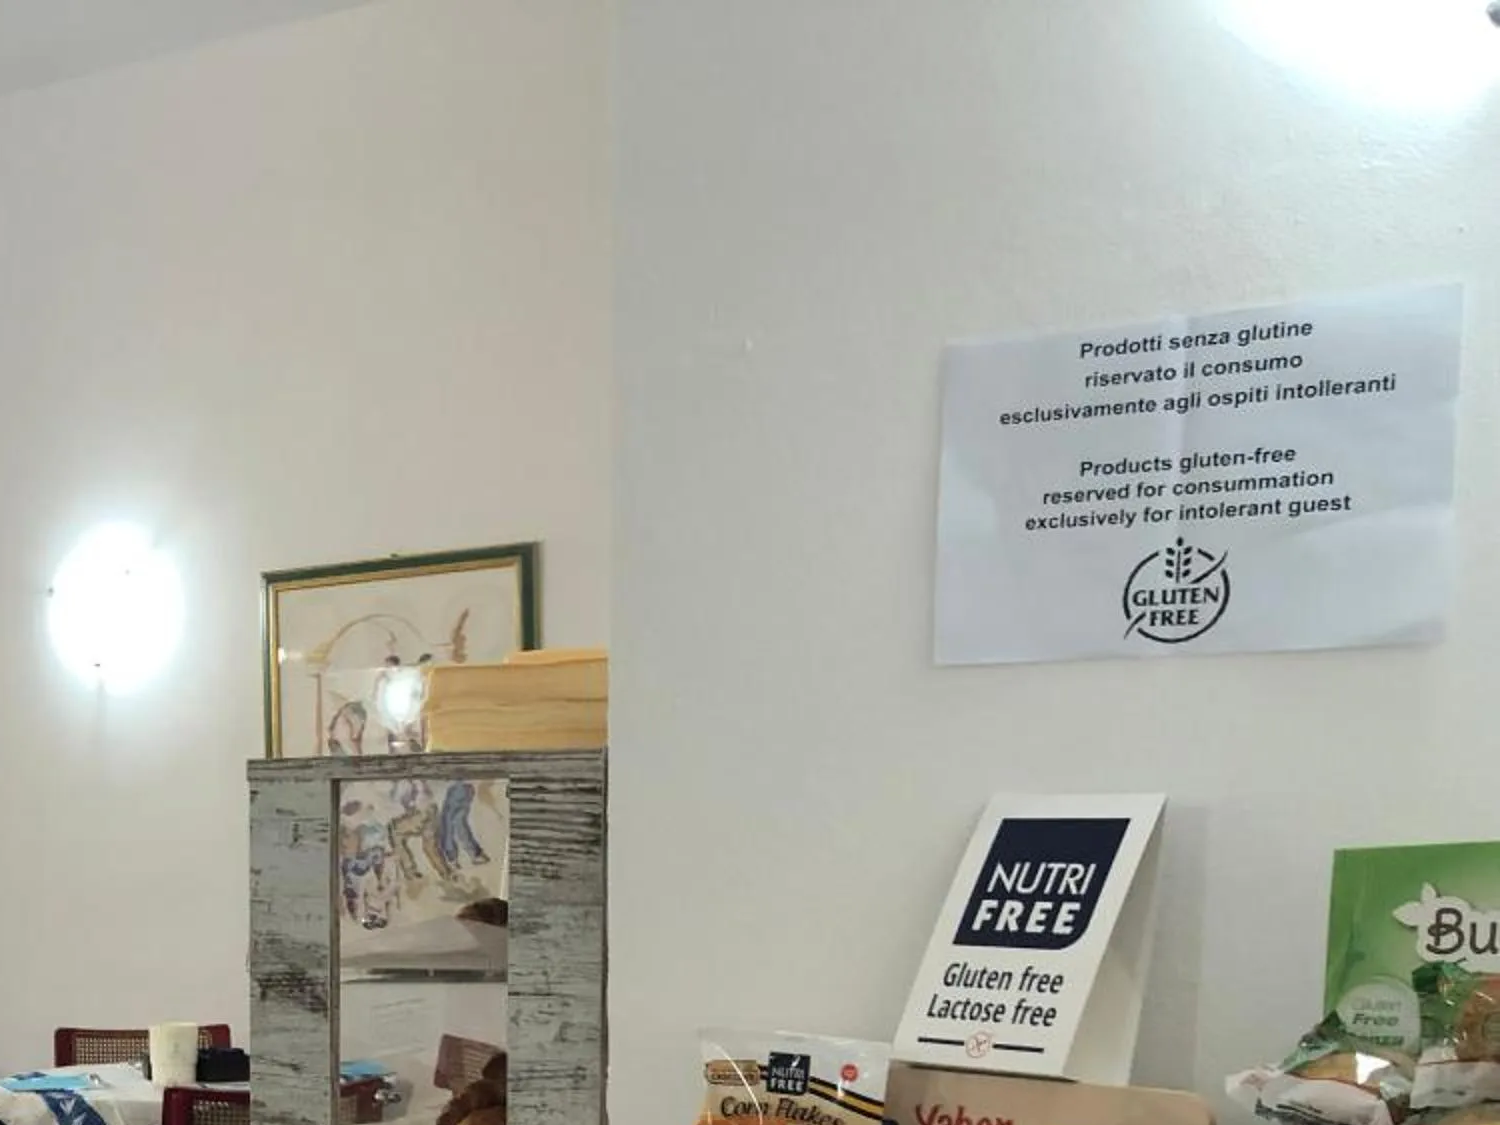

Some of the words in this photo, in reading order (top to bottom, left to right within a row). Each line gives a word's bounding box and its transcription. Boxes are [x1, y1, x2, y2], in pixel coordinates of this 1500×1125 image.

[1079, 335, 1162, 359] Prodotti
[1168, 331, 1230, 350] senza
[1237, 321, 1313, 347] glutine
[1085, 364, 1176, 388] riservato
[1183, 361, 1195, 379] il
[1201, 354, 1303, 377] consumo
[999, 399, 1157, 425] esclusivamente
[1164, 392, 1201, 414] agli
[1207, 385, 1269, 408] ospiti
[1276, 373, 1396, 401] intolleranti
[1079, 456, 1173, 477] Products
[1179, 447, 1297, 474] gluten-free
[1043, 483, 1130, 505] reserved
[1137, 481, 1166, 499] for
[1172, 471, 1334, 497] consummation
[1025, 509, 1136, 531] exclusively
[1143, 506, 1173, 523] for
[1178, 499, 1281, 521] intolerant
[1288, 495, 1352, 517] guest
[1132, 586, 1221, 607] GLUTEN
[1149, 609, 1200, 627] FREE
[986, 862, 1097, 895] NUTRI
[971, 899, 1081, 934] FREE
[943, 962, 1013, 991] Gluten
[1018, 966, 1064, 994] free
[927, 993, 1006, 1023] Lactose
[1011, 998, 1057, 1027] free
[1352, 1013, 1399, 1026] Free
[770, 1078, 804, 1092] FREE
[772, 1066, 805, 1080] NUTRI
[720, 1096, 769, 1118] Corn
